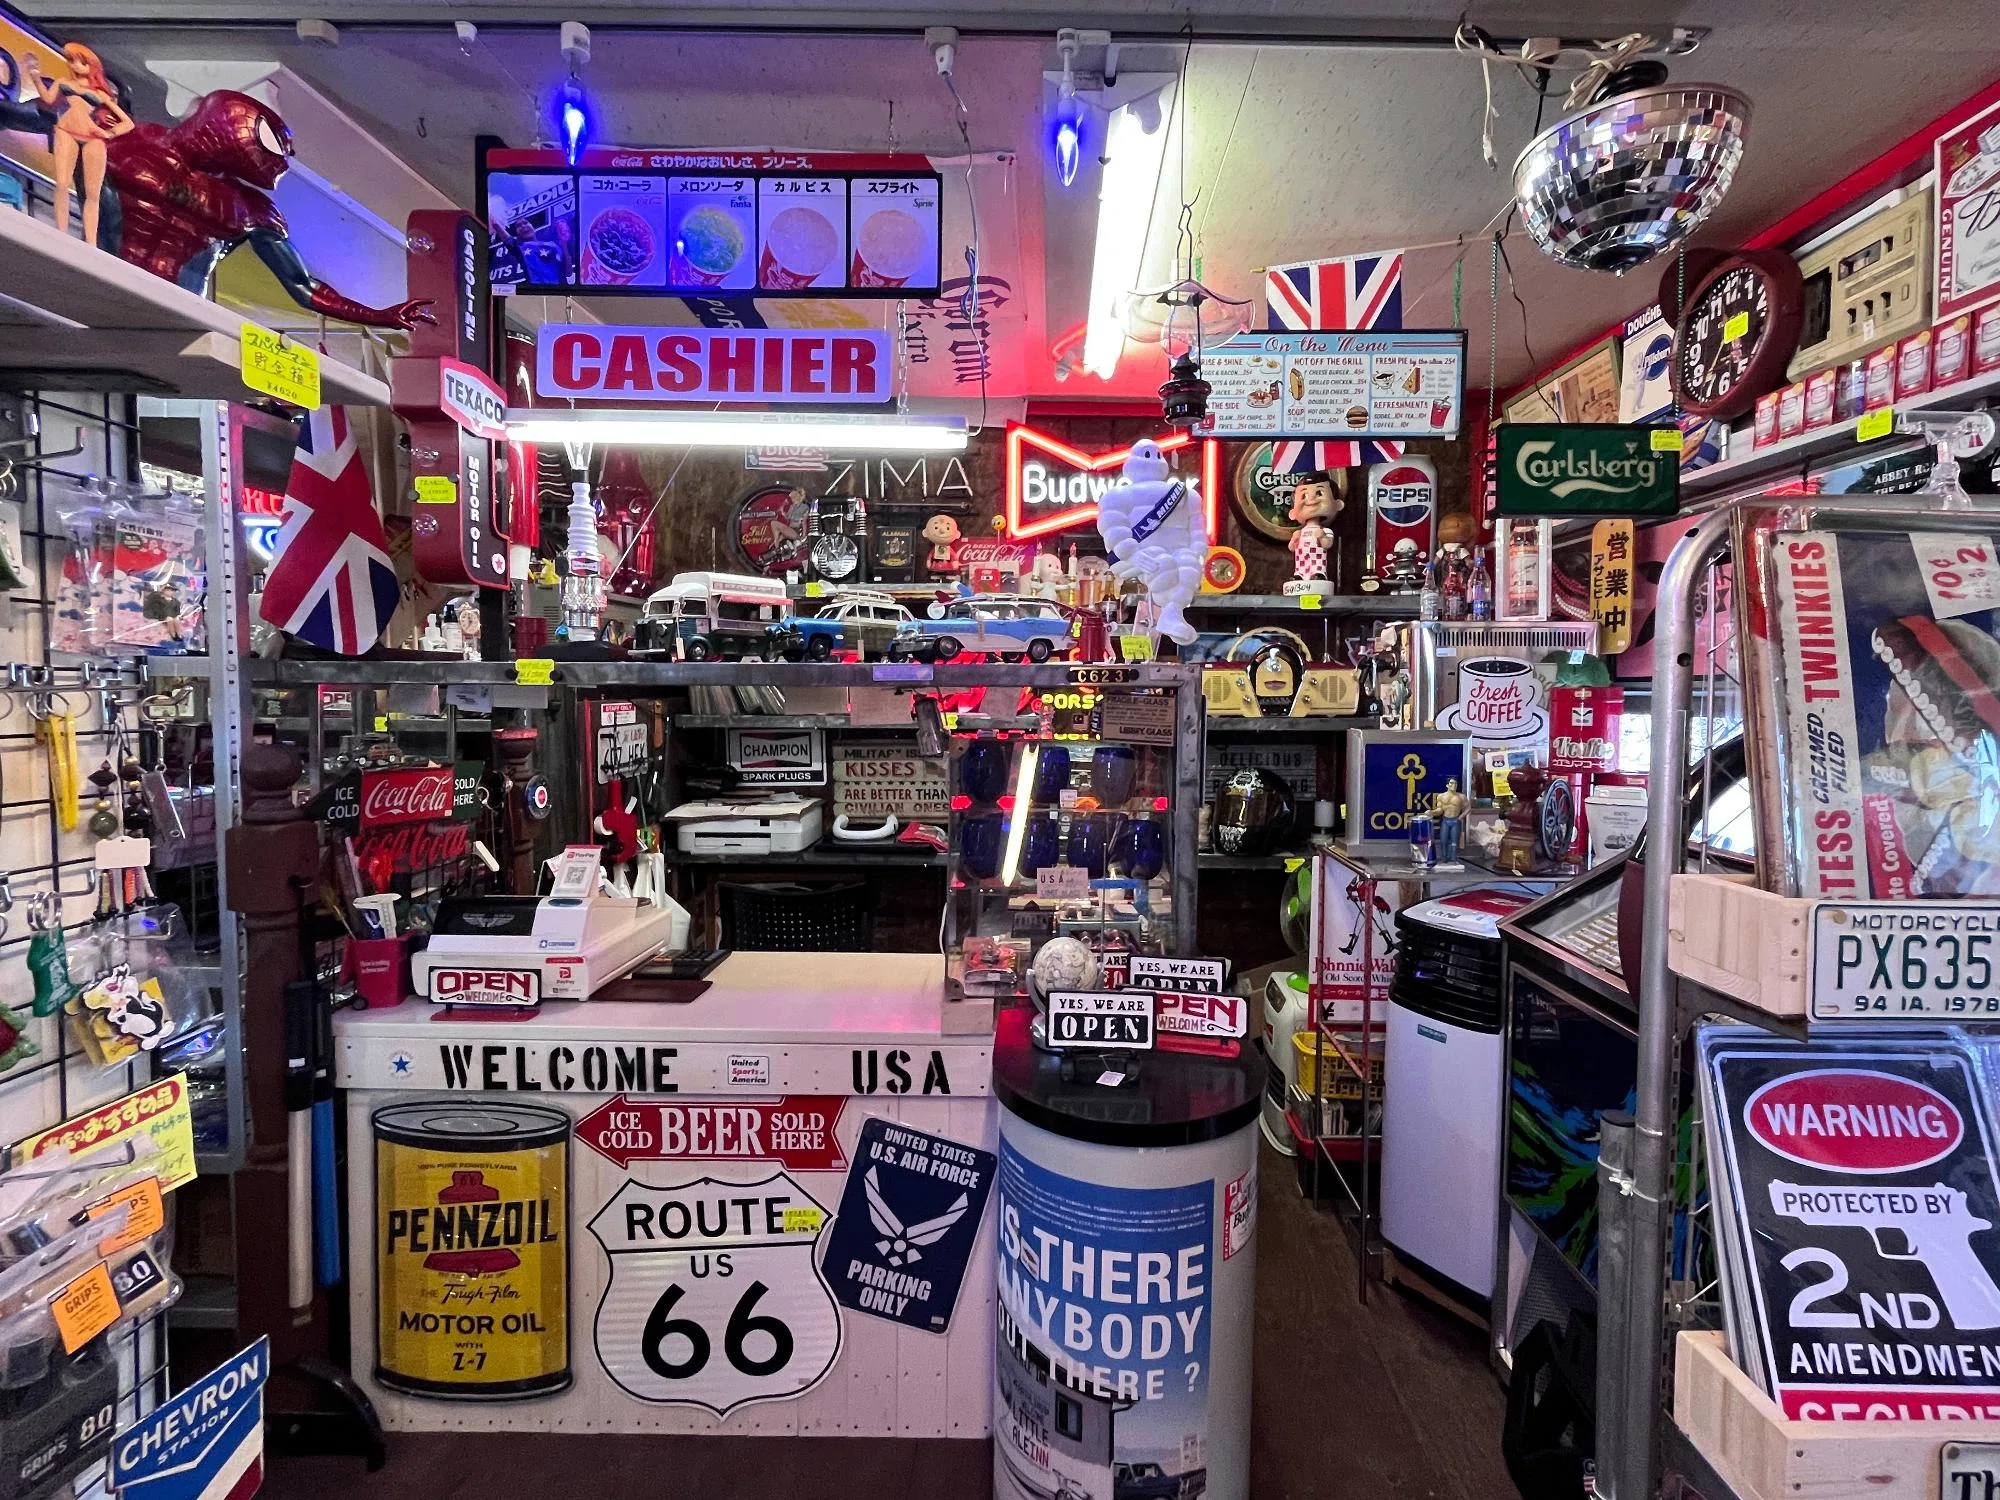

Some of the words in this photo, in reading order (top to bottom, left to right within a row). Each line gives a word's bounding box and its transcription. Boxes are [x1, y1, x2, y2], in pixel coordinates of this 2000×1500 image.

[592, 179, 652, 191] コカ・コーラ
[679, 180, 744, 192] メロンソーダ
[868, 182, 920, 194] スプライト
[1940, 208, 1953, 303] GENUINE
[463, 228, 476, 343] GASOLINE
[1264, 336, 1292, 352] On
[1295, 336, 1328, 352] the
[1337, 336, 1389, 352] Menu
[1689, 343, 1701, 366] 9
[552, 333, 877, 394] CASHIER
[1719, 372, 1730, 395] 6
[444, 374, 504, 425] TEXACO
[1516, 440, 1656, 487] Carlsberg
[1874, 466, 1911, 485] ABBEY
[467, 455, 480, 523] MOTOR
[825, 457, 973, 497] ZIMA
[1377, 488, 1432, 502] PEPSI
[470, 527, 482, 569] OIL
[1592, 553, 1604, 621] アサヒビール
[1604, 531, 1631, 634] 営業中
[1787, 540, 1841, 703] TWINKIES
[1470, 678, 1521, 700] Fresh
[1466, 700, 1523, 723] COFFEE
[743, 743, 809, 758] CHAMPION
[1219, 751, 1302, 768] DELICIOUS
[1806, 711, 1831, 805] CREAMED
[1827, 730, 1849, 794] FILLED
[742, 772, 776, 782] SPARK
[778, 771, 811, 781] PLUGS
[845, 762, 915, 777] KISSES
[335, 787, 355, 800] ICE
[454, 777, 475, 791] SOLD
[844, 789, 866, 800] ARE
[870, 788, 912, 800] BETTER
[327, 803, 359, 820] COLD
[453, 793, 474, 807] HERE
[844, 802, 904, 814] CIVILIAN
[1169, 963, 1187, 974] WE
[1190, 964, 1215, 976] ARE
[1325, 972, 1340, 981] Old
[436, 970, 532, 998] OPEN
[464, 991, 506, 1003] WELCOME
[1059, 998, 1088, 1012] YES,
[1094, 999, 1113, 1010] WE
[1118, 1000, 1145, 1011] ARE
[1855, 995, 1887, 1011] 94
[1944, 996, 1999, 1012] 1978
[1061, 1015, 1140, 1040] OPEN
[1158, 1016, 1207, 1032] WELCOME
[440, 1045, 678, 1092] WELCOME
[731, 1059, 760, 1067] United
[731, 1068, 758, 1076] Sports
[852, 1050, 951, 1095] USA
[731, 1076, 767, 1084] America
[609, 1111, 642, 1130] ICE
[660, 1107, 765, 1155] BEER
[770, 1112, 825, 1131] SOLD
[1762, 1103, 1949, 1139] WARNING
[598, 1131, 653, 1149] COLD
[771, 1131, 826, 1150] HERE
[884, 1127, 928, 1152] UNITED
[931, 1142, 976, 1166] STATES
[869, 1141, 898, 1165] U.S.
[899, 1151, 929, 1174] AIR
[928, 1159, 981, 1189] FORCE
[1782, 1192, 1918, 1214] PROTECTED
[1928, 1192, 1953, 1214] BY
[388, 1199, 559, 1255] PENNZOIL
[626, 1197, 792, 1240] ROUTE
[113, 1260, 151, 1292] 80
[690, 1253, 734, 1279] US
[1033, 1225, 1206, 1305] THERE
[847, 1259, 932, 1302] PARKING
[1779, 1246, 1941, 1330] 2ND
[64, 1282, 101, 1314] GRIPS
[859, 1285, 910, 1318] ONLY
[400, 1311, 494, 1334] MOTOR
[501, 1312, 547, 1334] OIL
[641, 1280, 795, 1380] 66
[1049, 1355, 1166, 1401] THERE
[1184, 1361, 1201, 1393] ?
[79, 1404, 113, 1442] 80
[118, 1354, 260, 1471] CHEVRON
[157, 1406, 230, 1466] STATION
[20, 1440, 68, 1480] GRIPS
